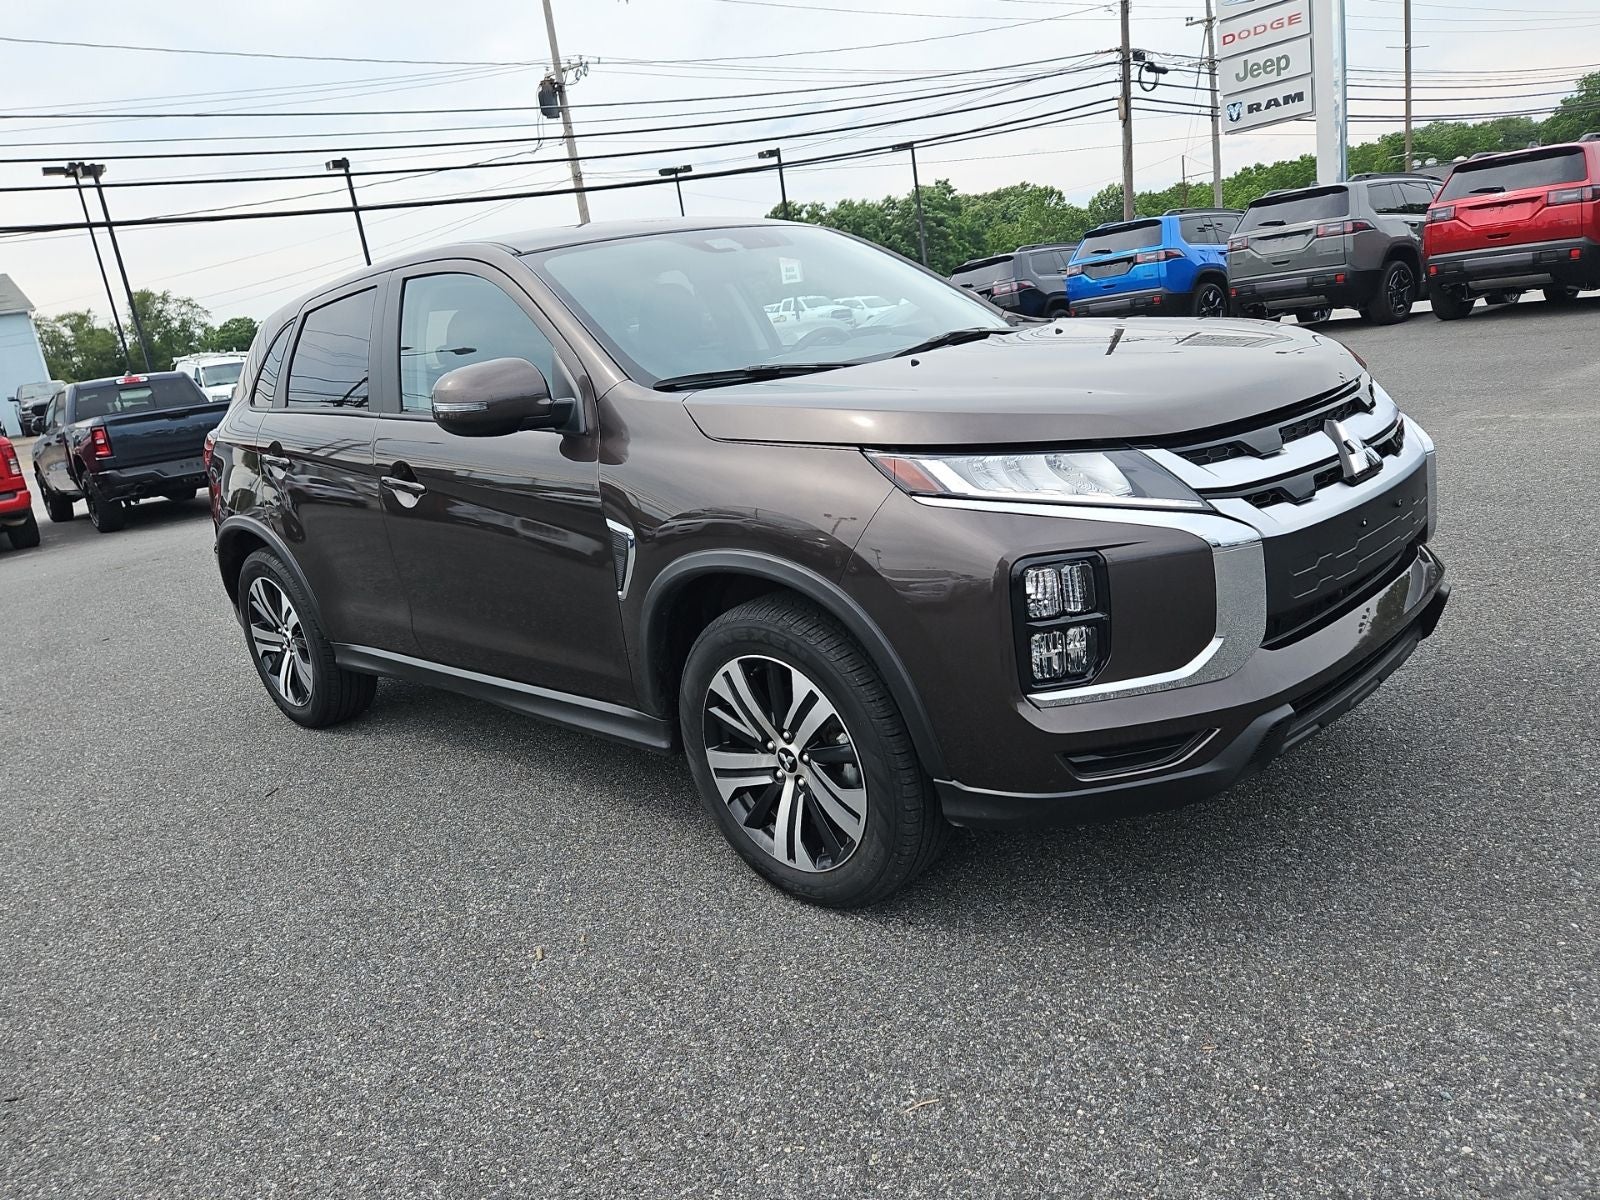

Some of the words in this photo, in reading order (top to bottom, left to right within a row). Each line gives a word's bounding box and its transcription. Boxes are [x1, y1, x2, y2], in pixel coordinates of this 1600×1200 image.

[1222, 12, 1302, 46] DODGE
[1235, 54, 1291, 82] Jeep
[1247, 91, 1304, 114] RAM
